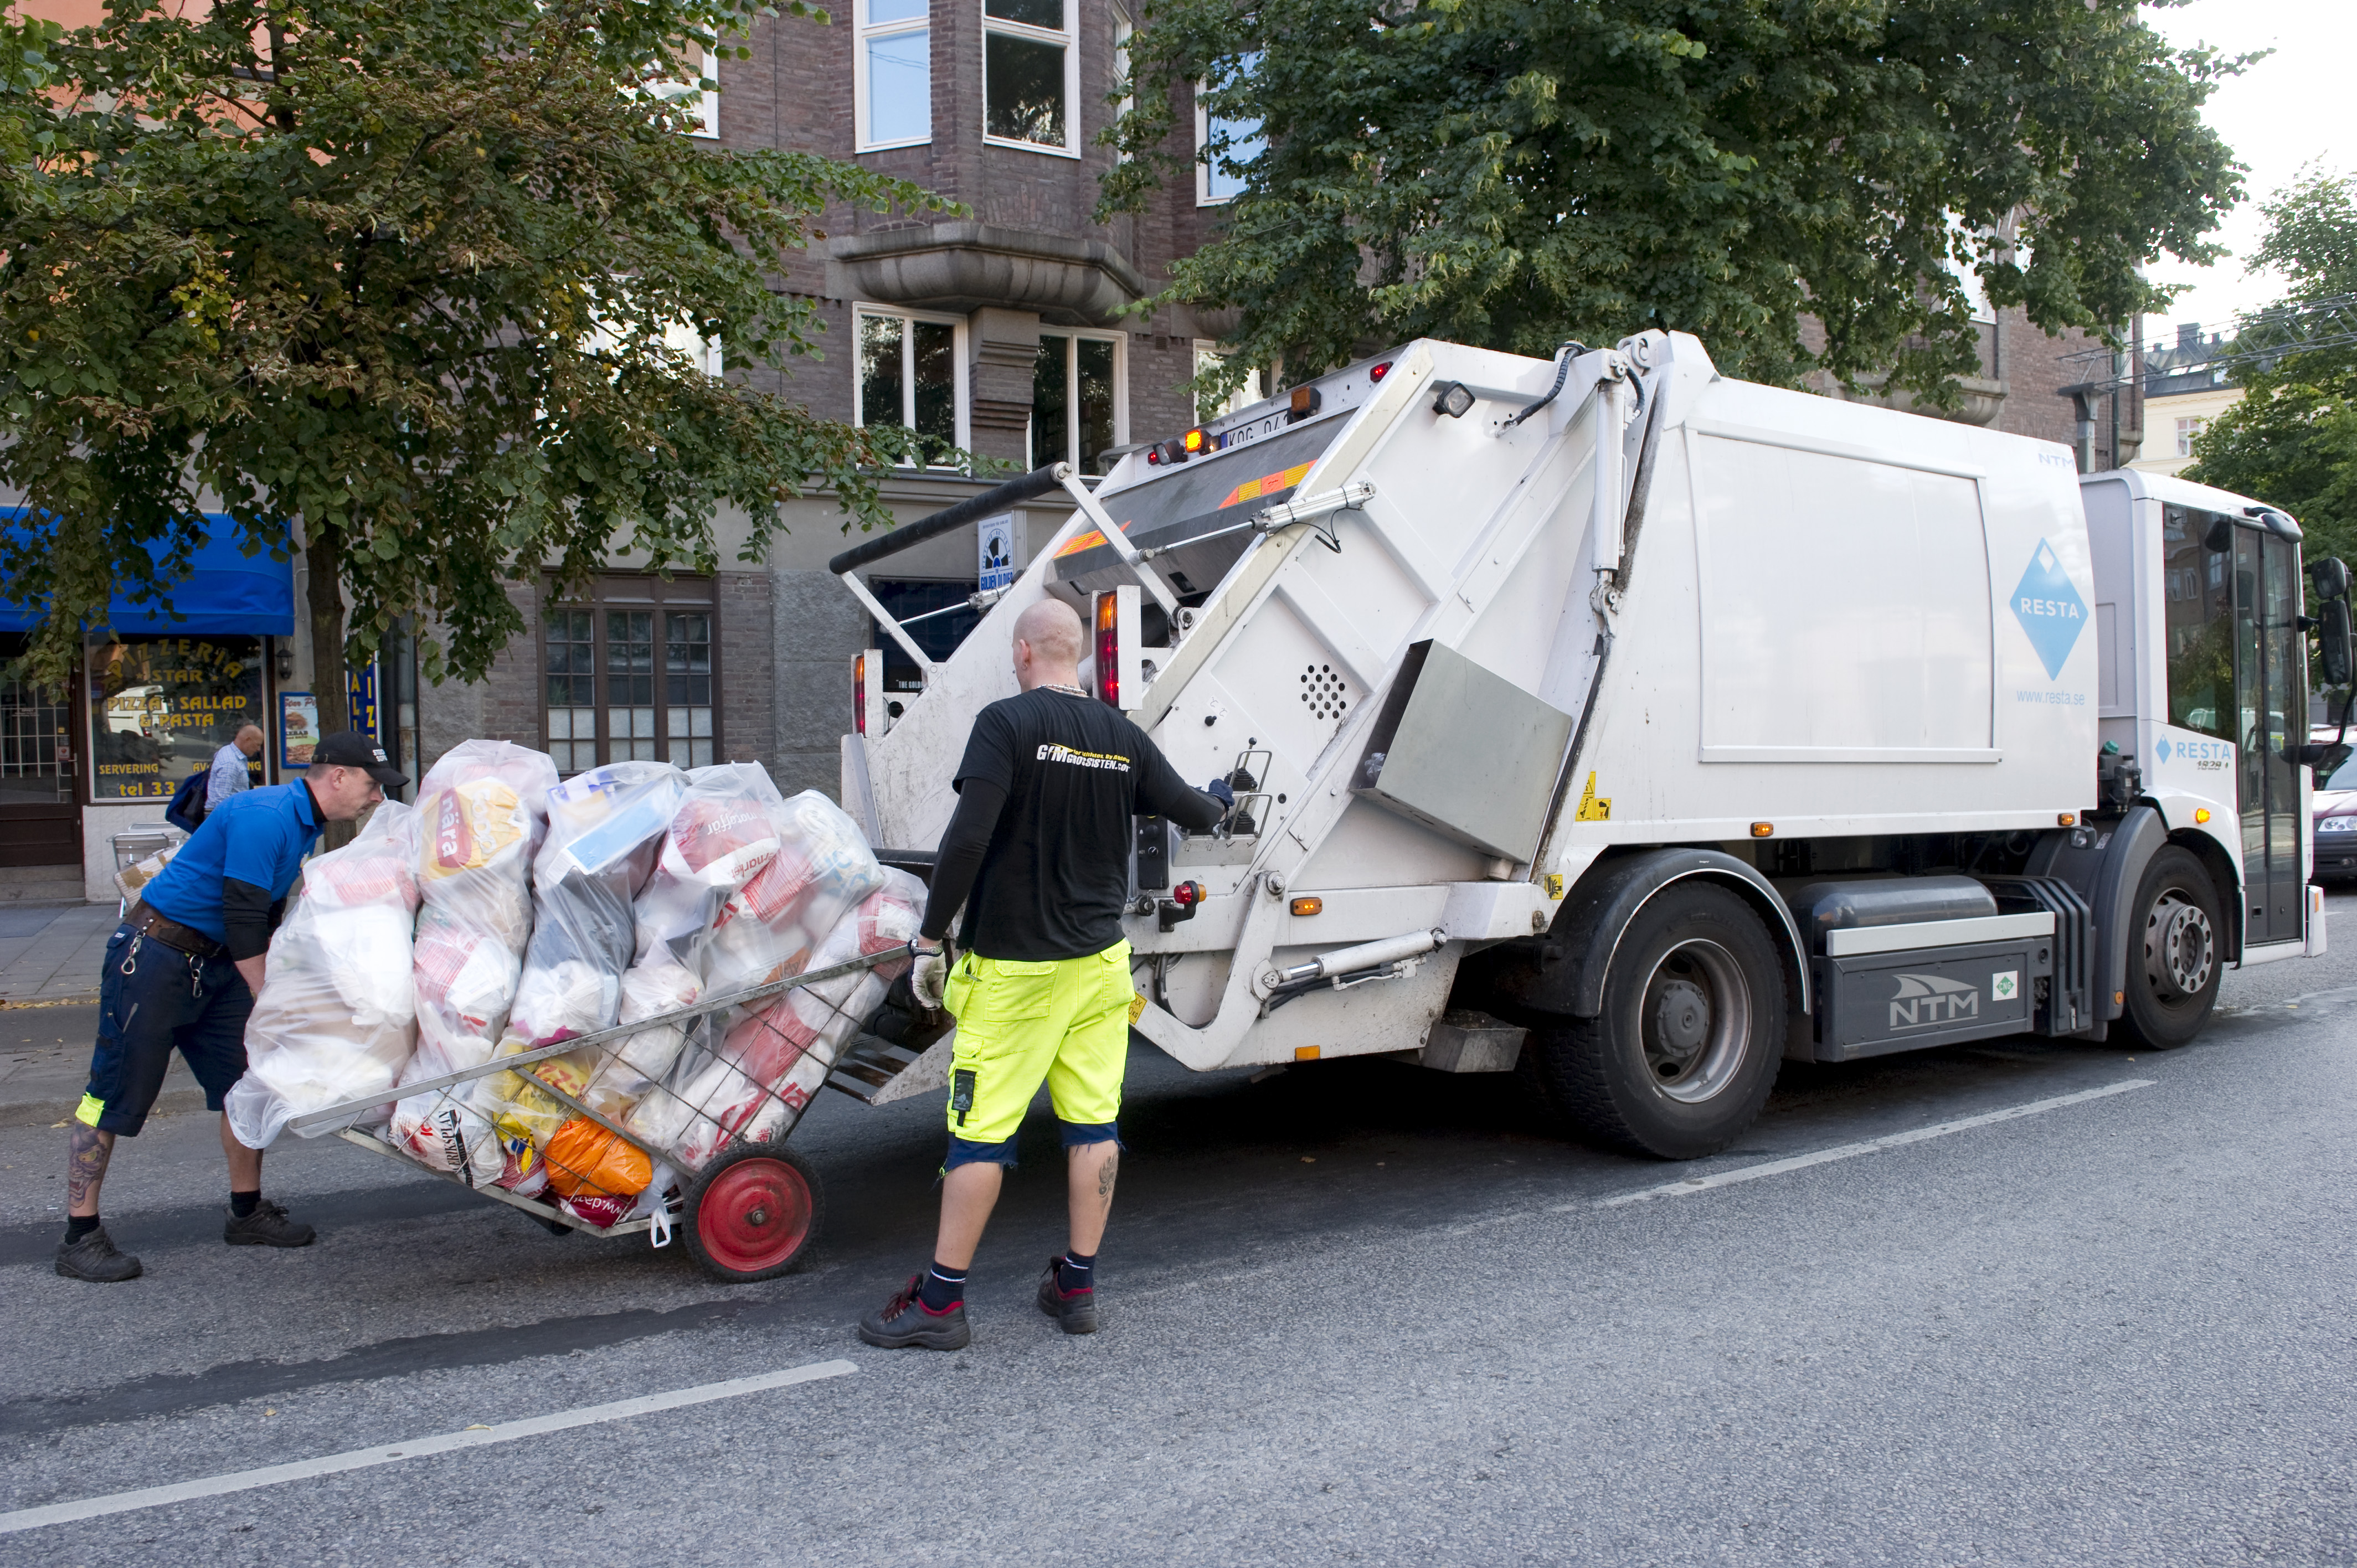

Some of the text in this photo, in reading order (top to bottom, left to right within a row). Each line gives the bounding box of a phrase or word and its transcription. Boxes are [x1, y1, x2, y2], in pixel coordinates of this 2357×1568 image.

[2038, 453, 2075, 469] NTM
[981, 575, 997, 591] GOLDEN
[2020, 597, 2080, 619] RESTA
[106, 638, 244, 679] PIZZERIA
[152, 669, 203, 683] STAR
[899, 680, 908, 689] THE
[107, 696, 162, 711] PIZZA
[179, 695, 247, 711] SALLAD
[2016, 690, 2085, 706] www.resta.se
[139, 713, 214, 728] & PASTA
[2176, 742, 2231, 760] RESTA
[99, 763, 158, 775] SERVERING
[119, 782, 143, 796] tel
[441, 796, 459, 858] nära
[707, 812, 758, 835] mataffär
[1998, 981, 2012, 991] CNG
[1890, 991, 1979, 1027] NTM
